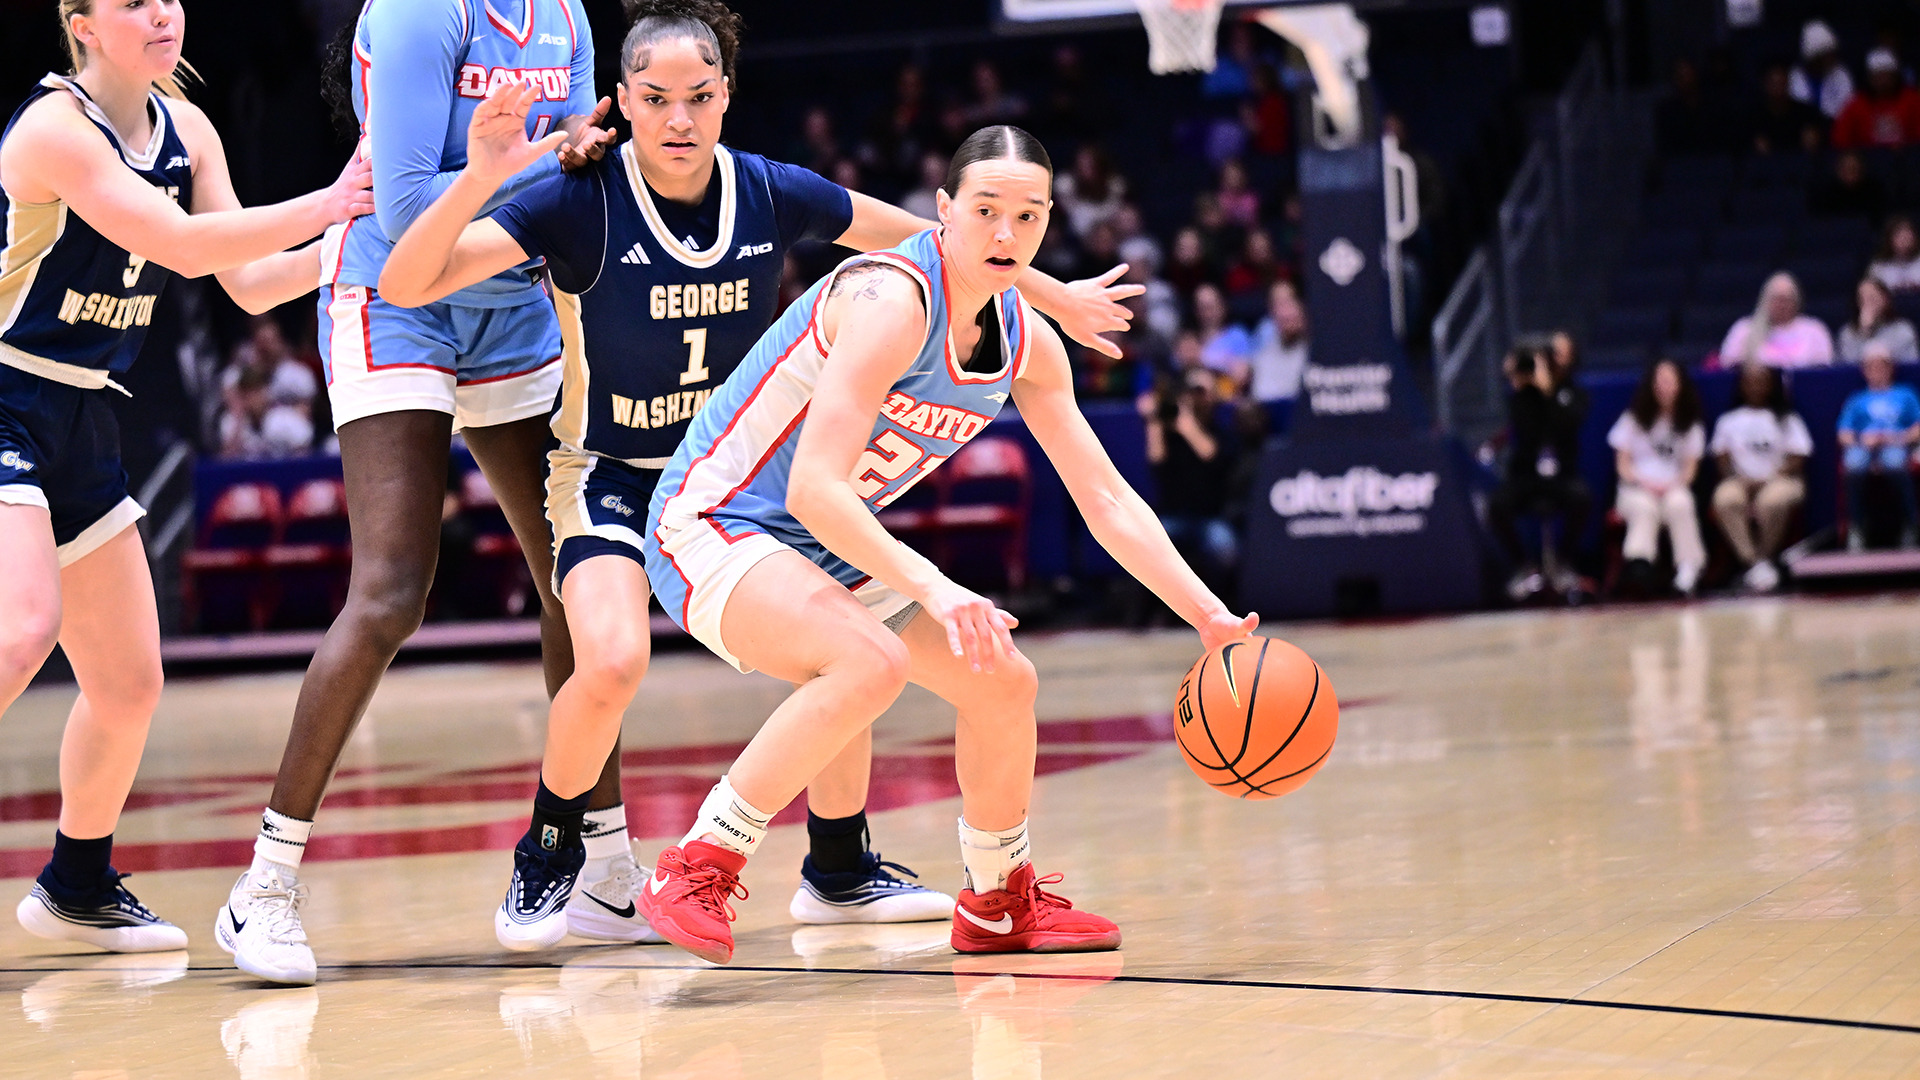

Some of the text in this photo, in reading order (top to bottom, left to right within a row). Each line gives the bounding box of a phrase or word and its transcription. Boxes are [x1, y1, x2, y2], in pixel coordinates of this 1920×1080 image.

[455, 63, 571, 102] DAYTON
[165, 156, 191, 170] A1
[736, 242, 774, 260] A10
[650, 278, 749, 320] GEORGE
[679, 327, 710, 386] 1
[611, 384, 722, 430] WASHIN
[880, 390, 995, 444] DAYTO
[848, 428, 949, 507] 21
